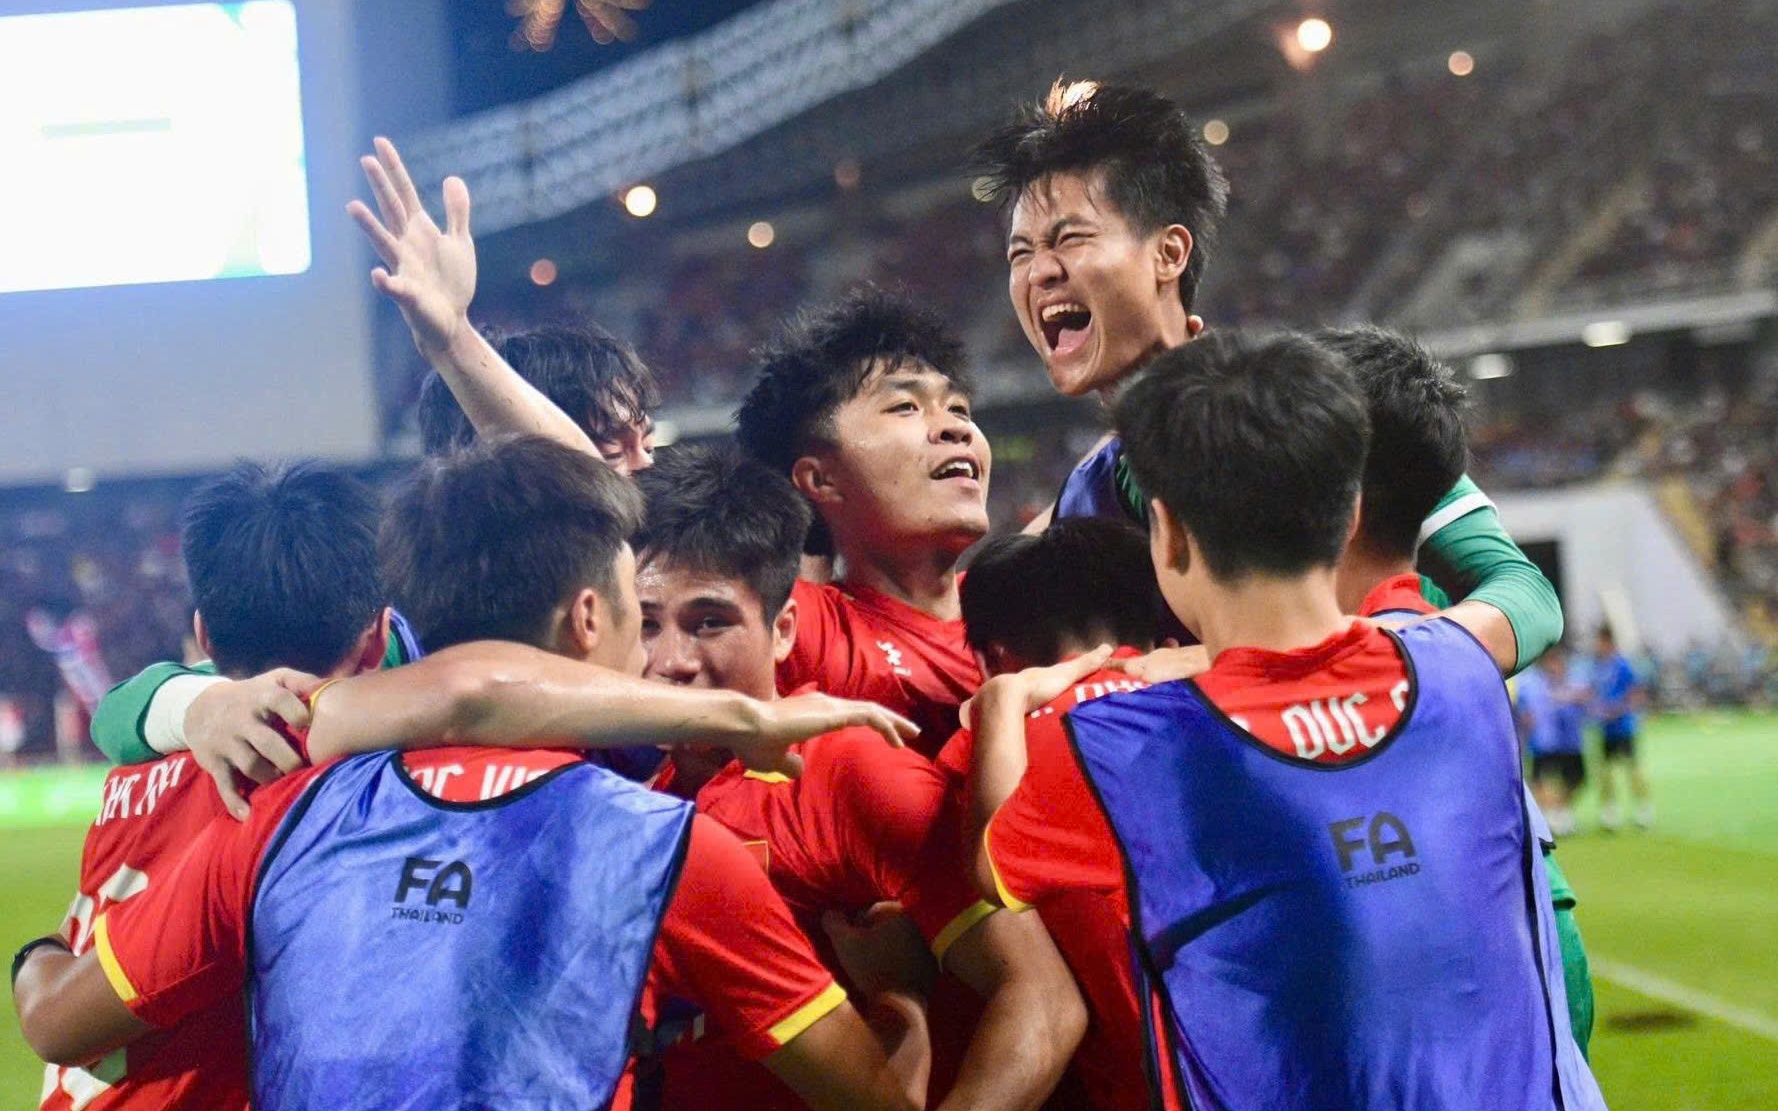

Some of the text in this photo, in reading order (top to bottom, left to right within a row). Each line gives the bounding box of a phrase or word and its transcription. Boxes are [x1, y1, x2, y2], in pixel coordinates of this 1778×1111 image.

[1281, 692, 1386, 760] DUC
[1327, 812, 1416, 873] FA
[394, 857, 472, 909] FA
[1347, 862, 1421, 888] THAILAND
[392, 907, 464, 924] THAILAND
